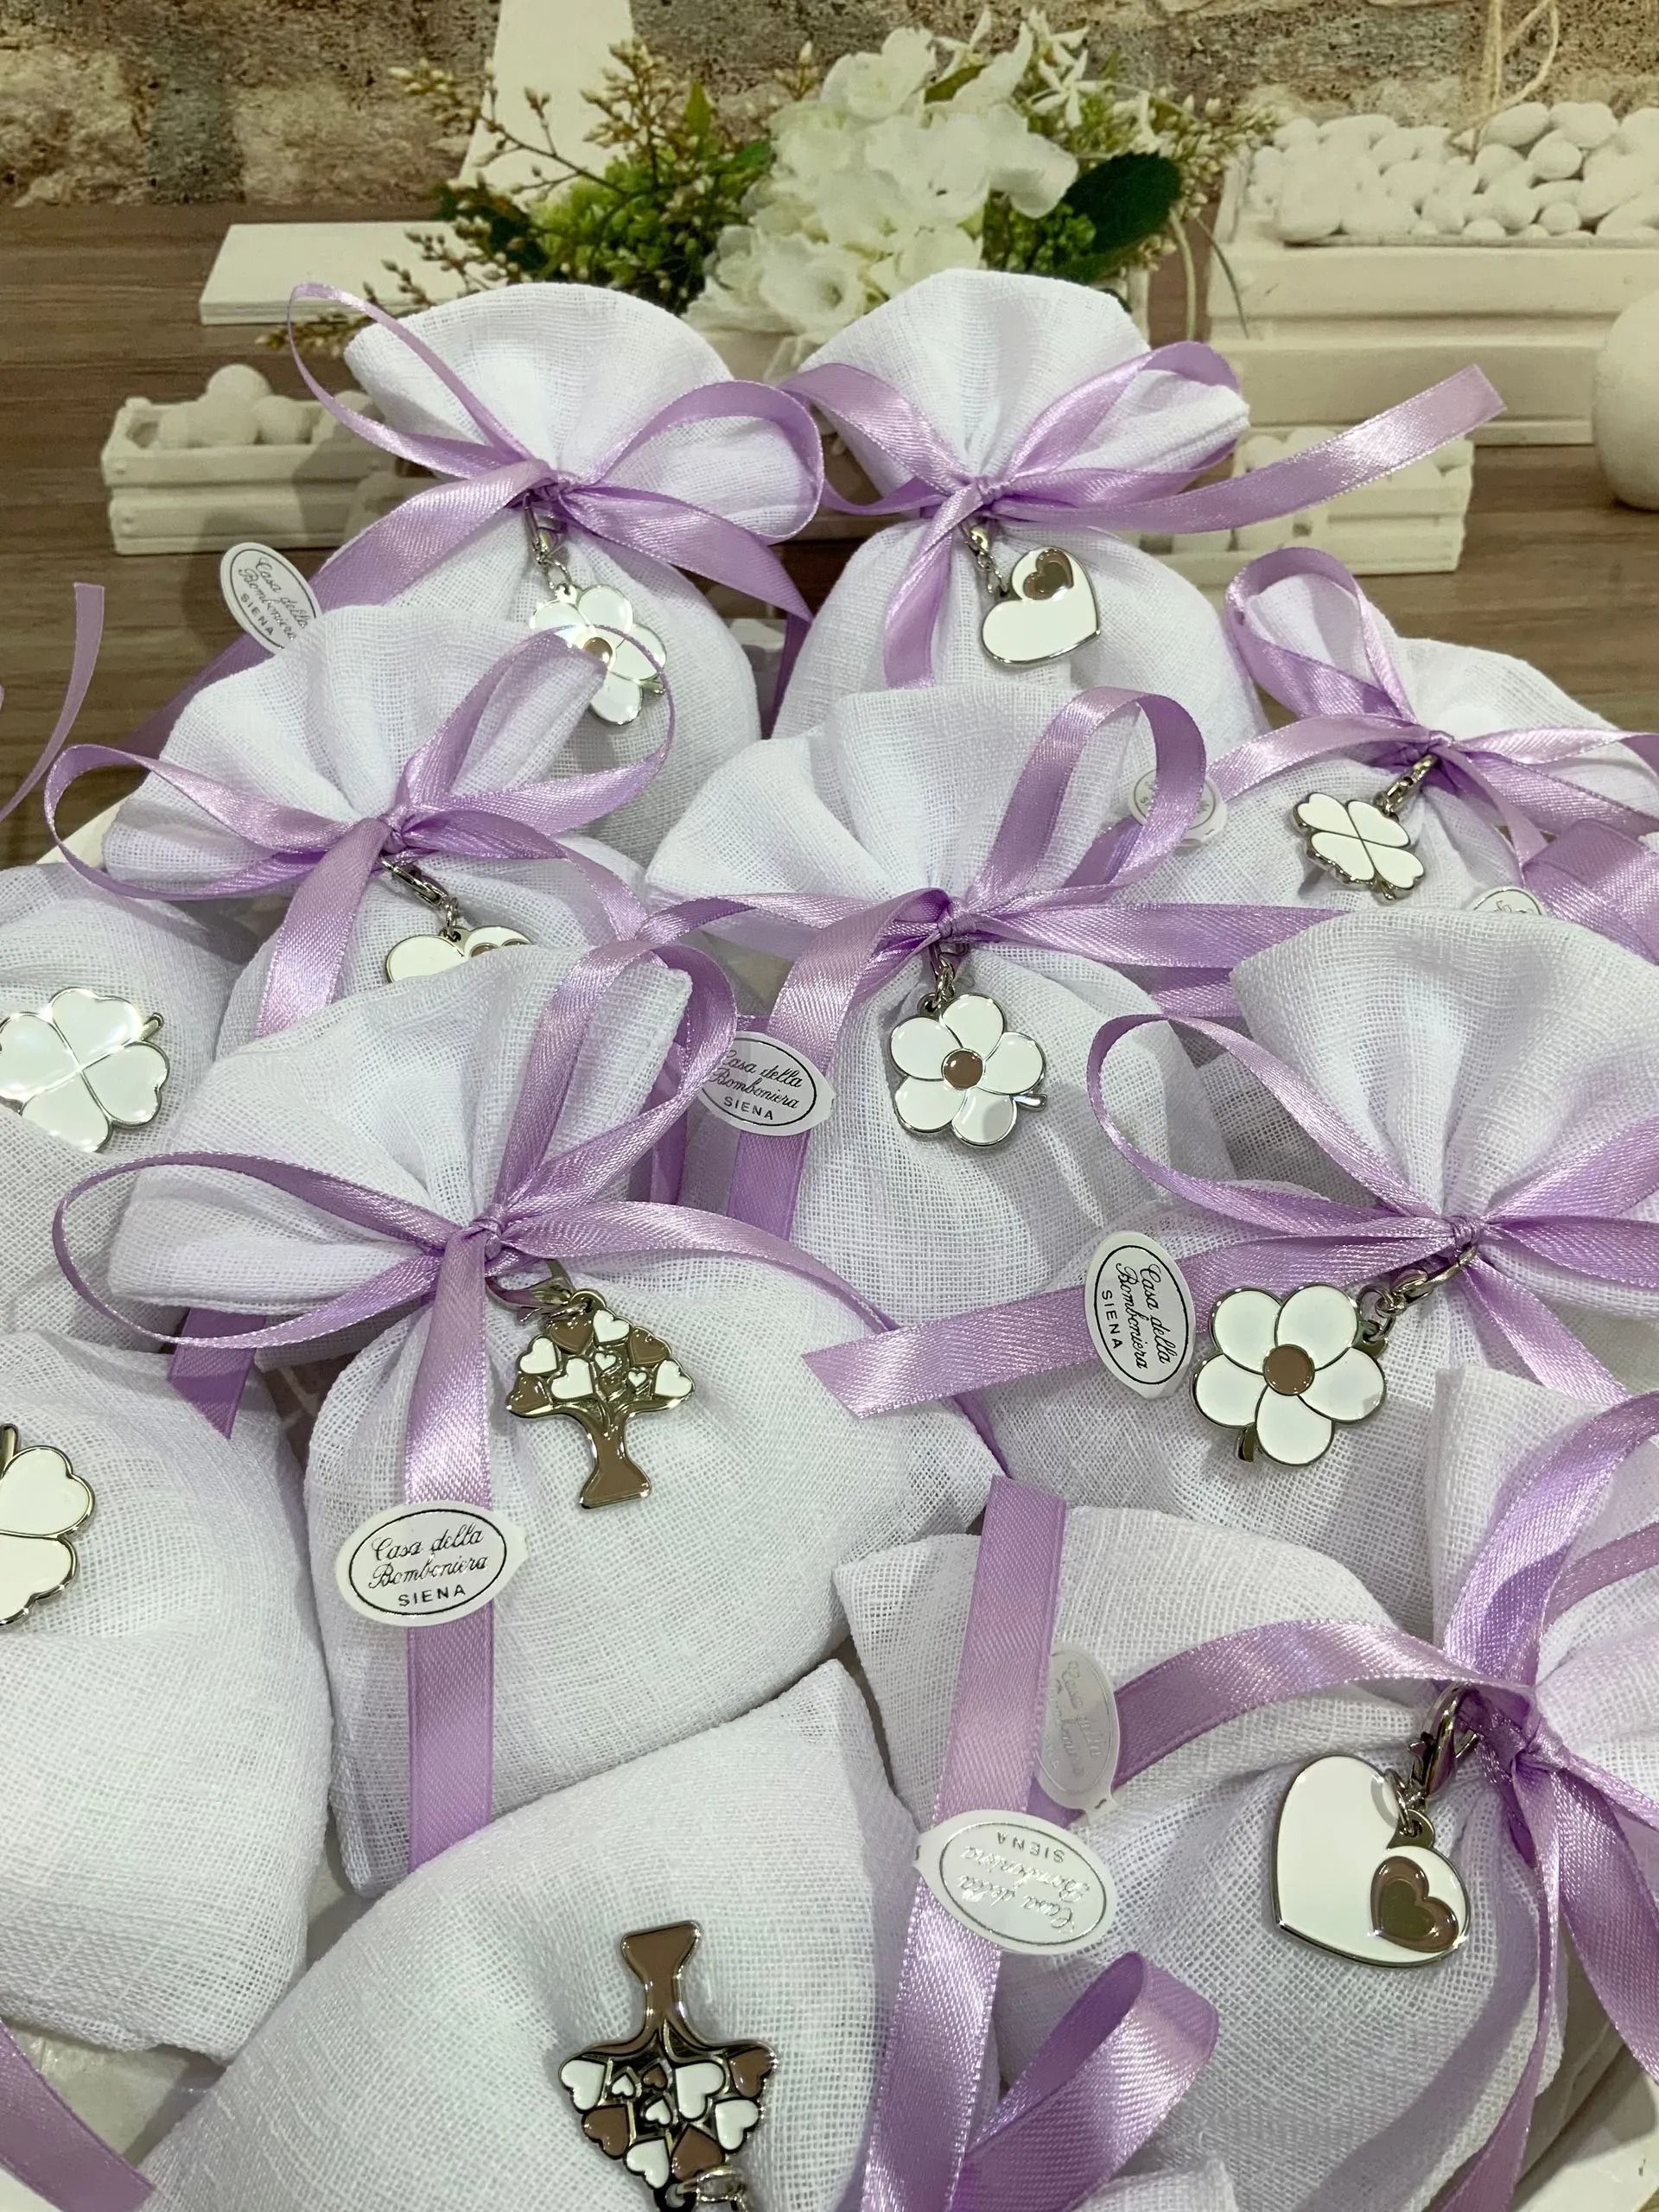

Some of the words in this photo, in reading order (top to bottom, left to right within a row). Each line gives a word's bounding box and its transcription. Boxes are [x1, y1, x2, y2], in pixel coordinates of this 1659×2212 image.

[256, 556, 281, 592] Casa
[241, 593, 274, 636] SIENA
[709, 1067, 800, 1109] Bomboniera
[722, 1049, 756, 1074] Casa
[760, 1065, 803, 1088] della
[723, 1096, 773, 1120] SIENA
[1140, 1263, 1161, 1310] Casa
[1102, 1290, 1123, 1349] SIENA
[1116, 1262, 1149, 1370] Bomboniera
[1150, 1314, 1178, 1363] della
[371, 1537, 423, 1560] Casa
[430, 1522, 484, 1553] della
[368, 1554, 488, 1589] Bomboniera
[398, 1585, 466, 1606] SIENA
[997, 1832, 1065, 1863] SIENA
